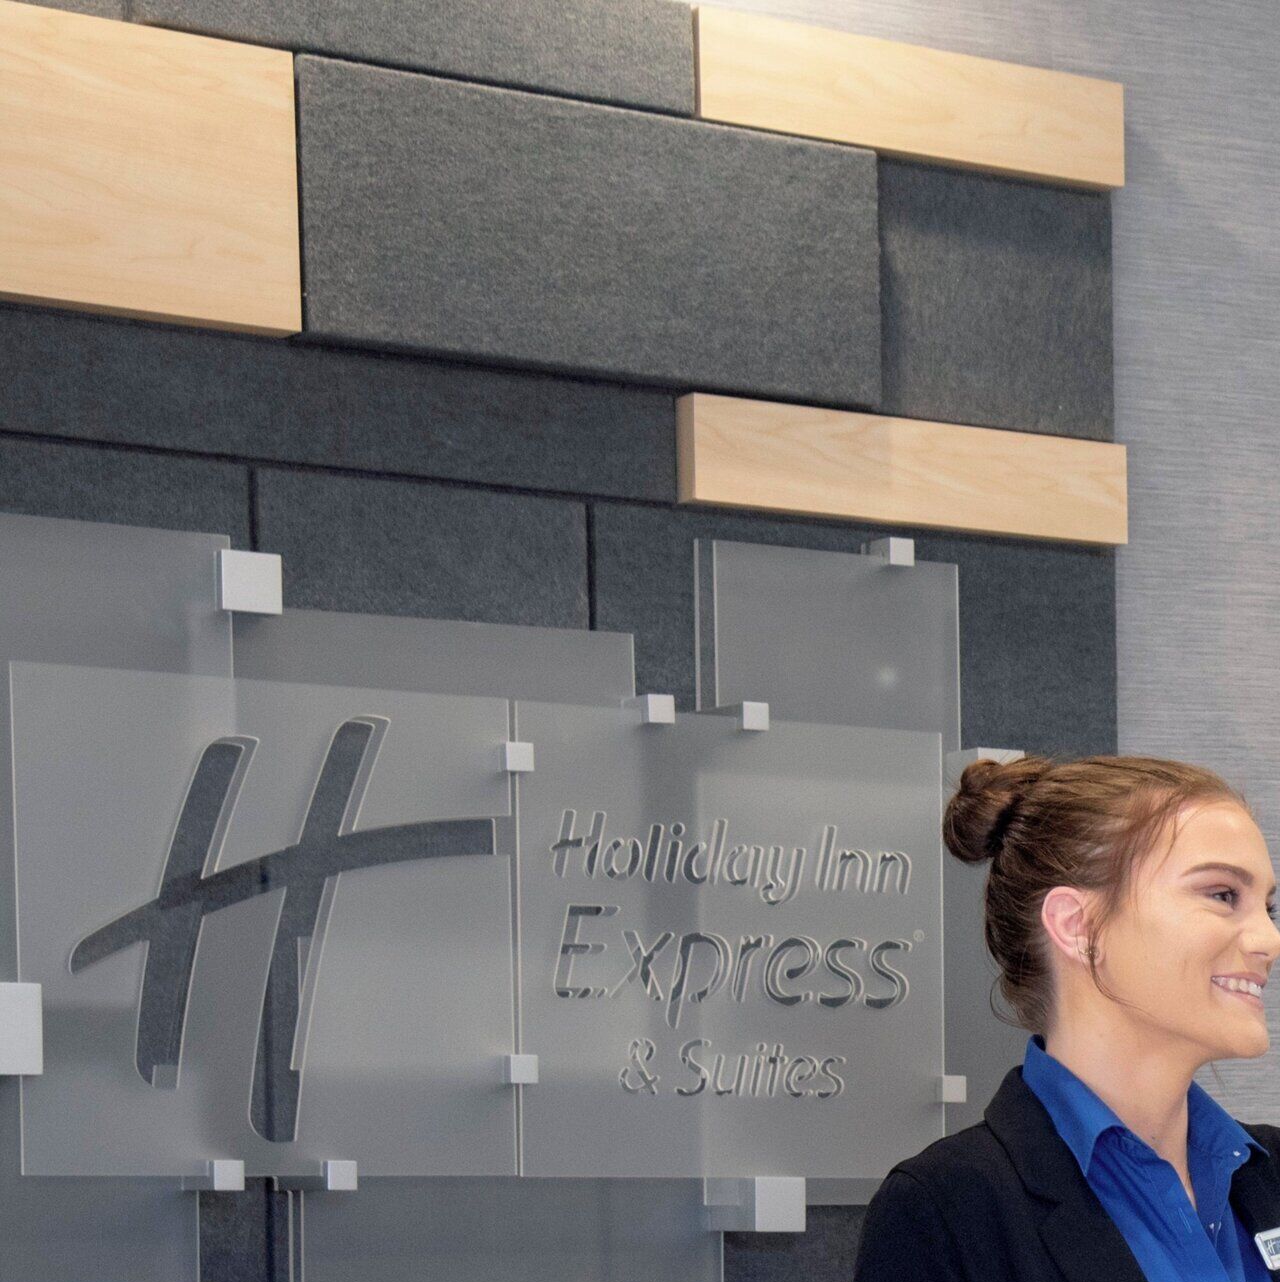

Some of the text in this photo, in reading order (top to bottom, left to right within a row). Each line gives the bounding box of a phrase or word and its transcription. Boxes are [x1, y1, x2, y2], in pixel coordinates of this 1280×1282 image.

[550, 807, 913, 906] Holiday Inn
[552, 902, 913, 1030] Express
[618, 1037, 847, 1099] & Suites
